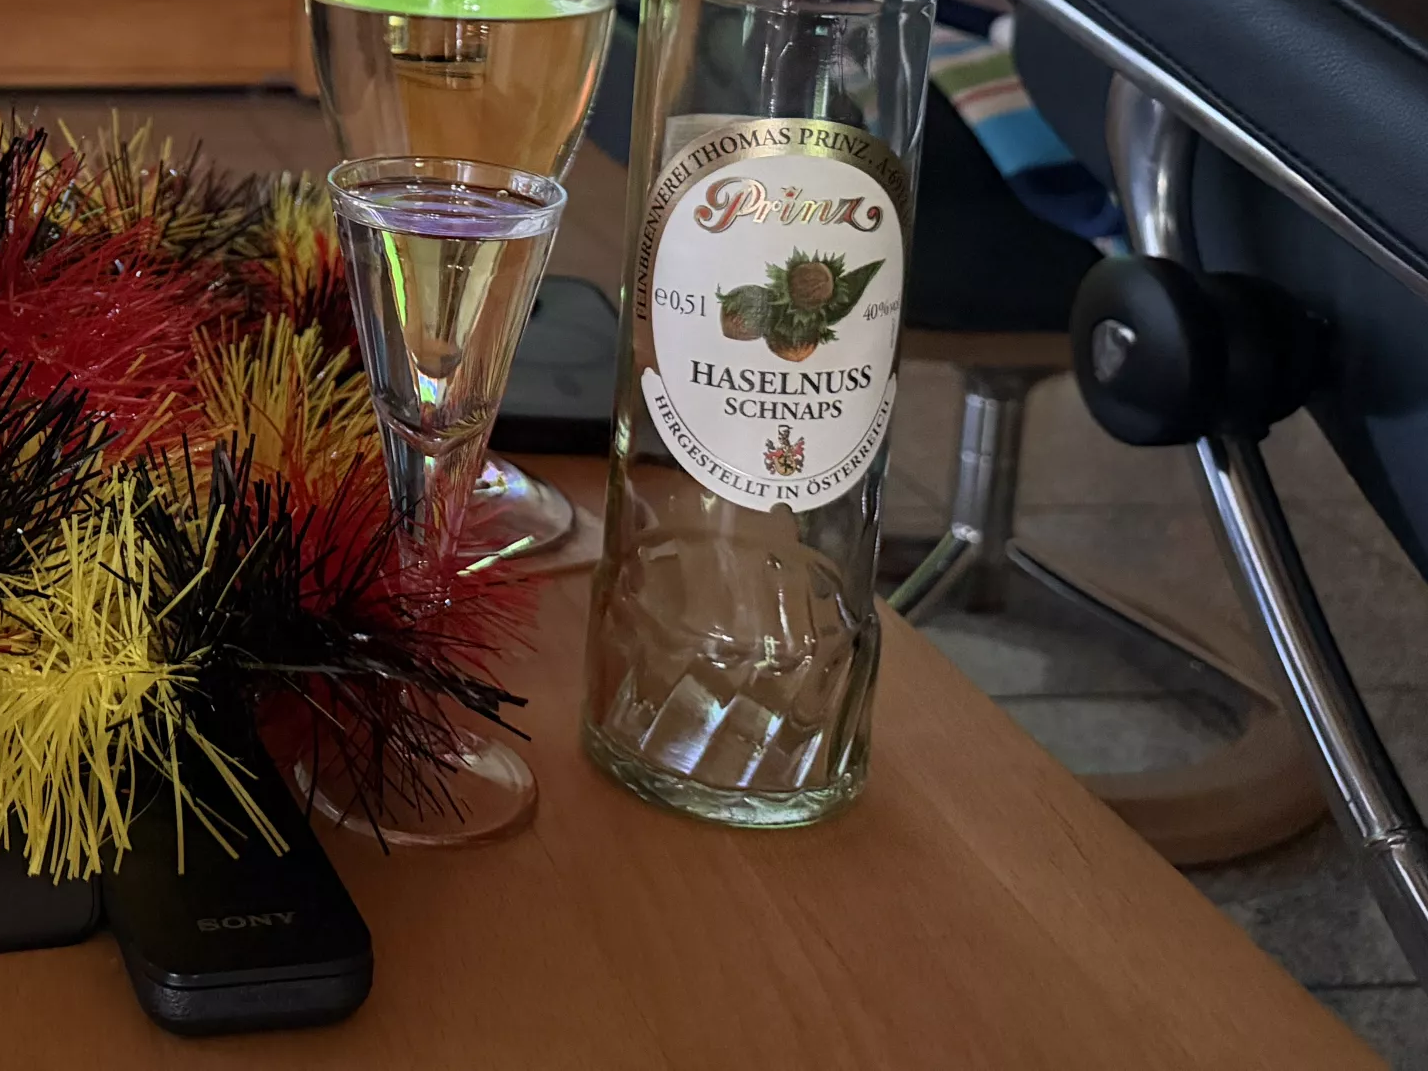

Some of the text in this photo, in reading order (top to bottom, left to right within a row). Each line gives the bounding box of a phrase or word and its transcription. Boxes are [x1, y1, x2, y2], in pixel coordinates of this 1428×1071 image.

[688, 127, 791, 170] THOMAS
[693, 176, 883, 233] Prinz
[689, 360, 873, 395] HASELNUSS
[724, 397, 843, 420] SCHNAPS
[654, 395, 890, 499] HERGESTELLT IN ÖSTERREICH
[196, 911, 296, 932] SONY
